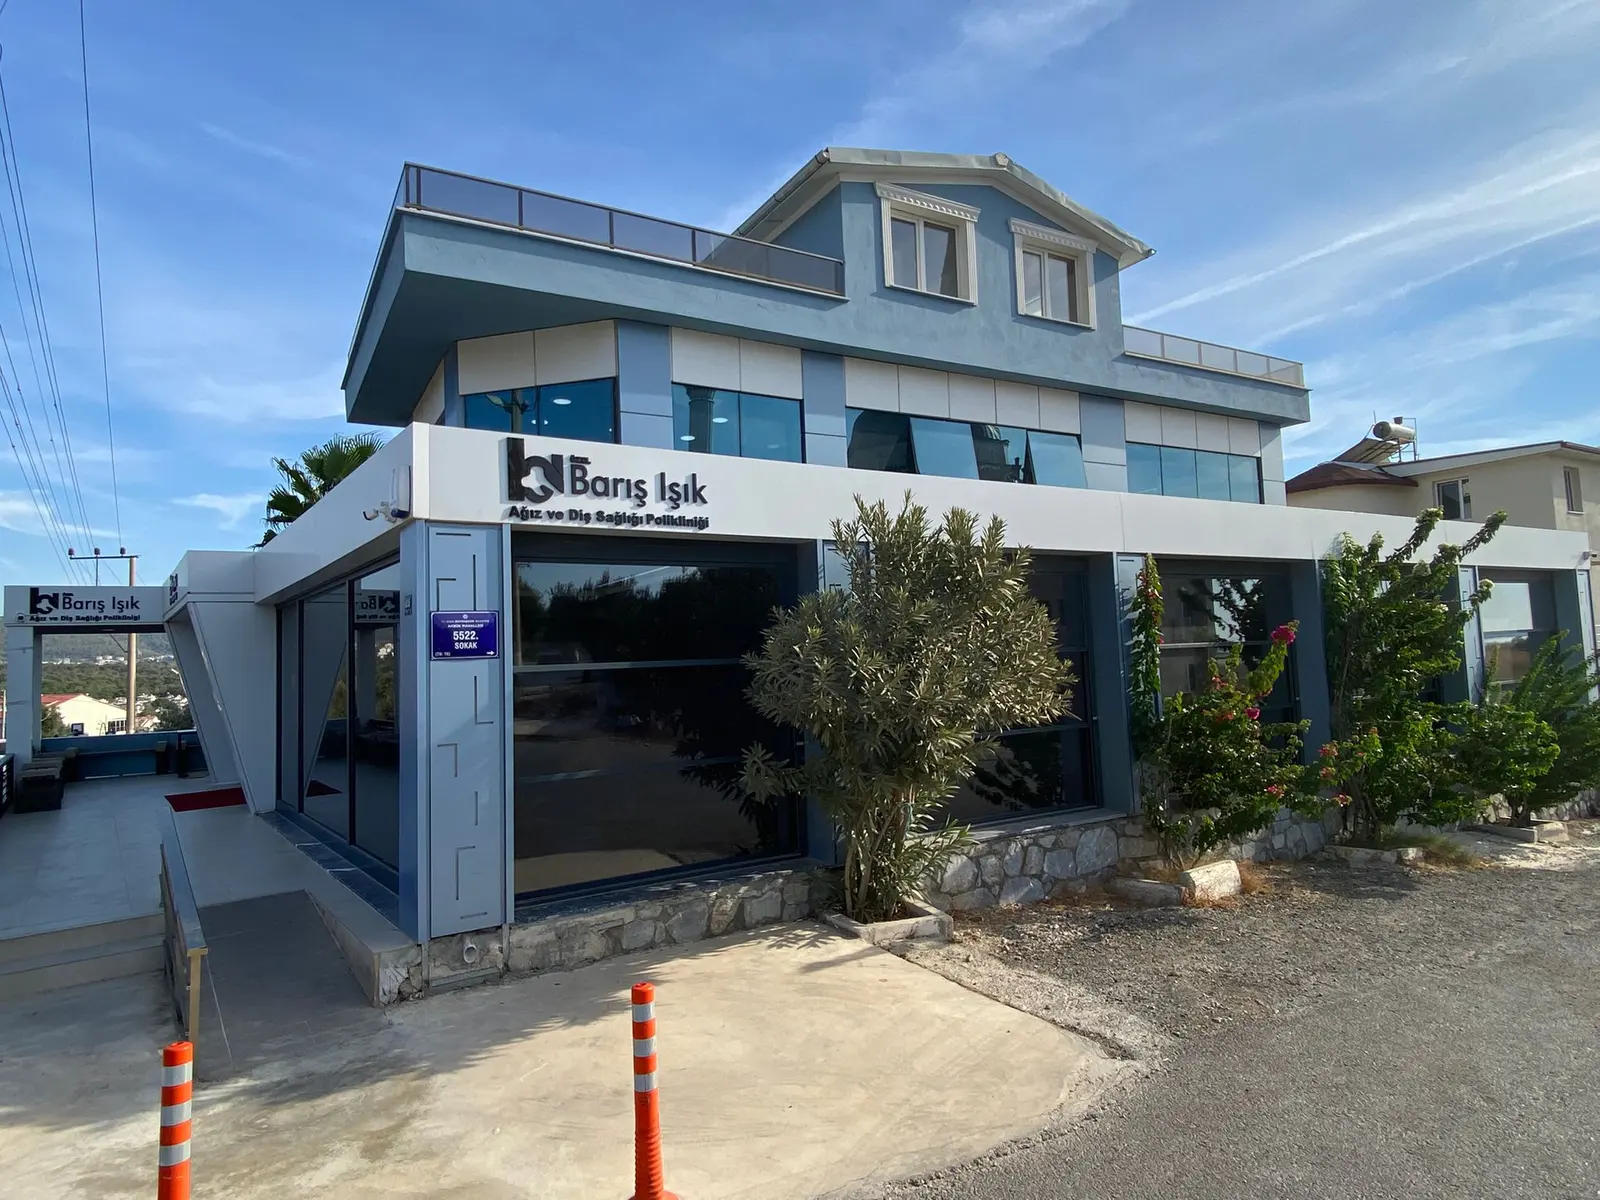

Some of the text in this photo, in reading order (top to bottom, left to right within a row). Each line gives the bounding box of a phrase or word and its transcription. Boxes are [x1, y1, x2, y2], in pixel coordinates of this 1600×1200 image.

[571, 464, 709, 510] Barış Işık
[508, 505, 710, 530] Ağız ve Diş Sağlığı Polikliniği
[62, 595, 141, 613] Barış Işık
[453, 631, 479, 640] 5522.
